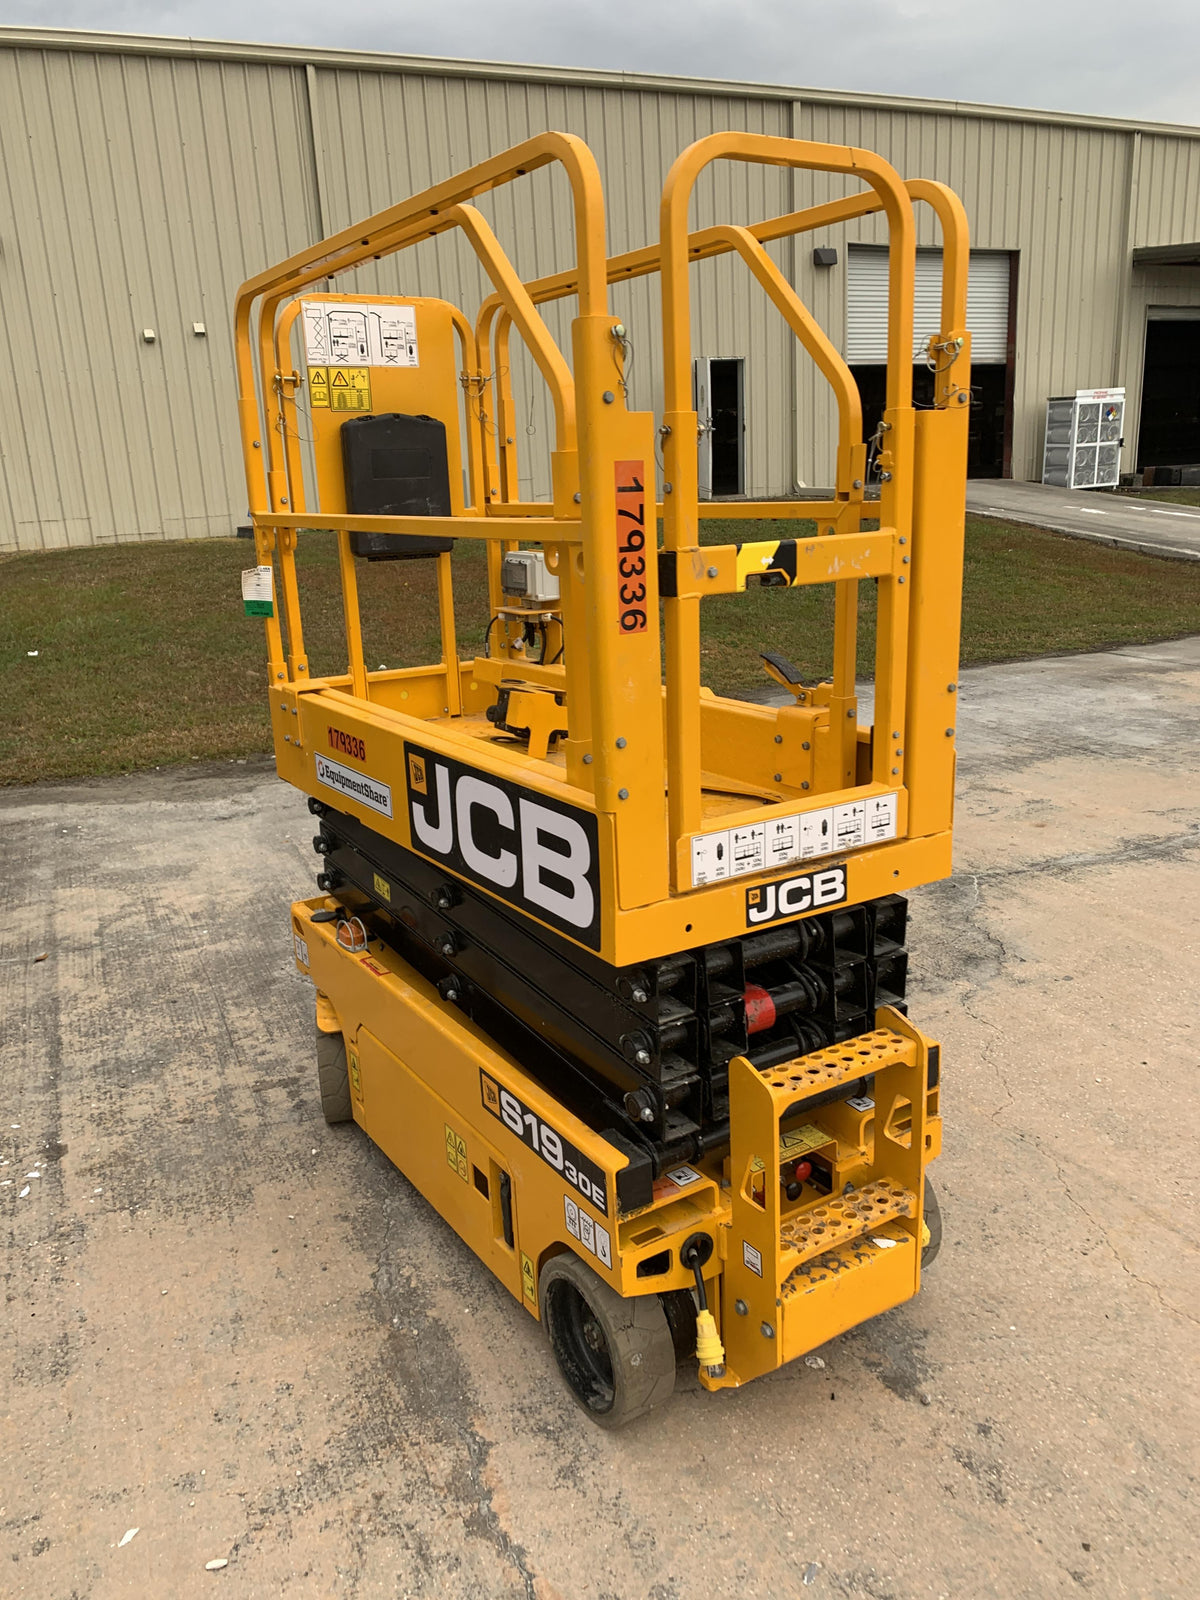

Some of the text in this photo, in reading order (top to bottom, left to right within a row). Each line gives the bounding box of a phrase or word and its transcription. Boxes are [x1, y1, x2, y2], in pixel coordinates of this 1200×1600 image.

[617, 476, 647, 631] 179336
[328, 727, 366, 760] 179336
[325, 764, 388, 807] EquipmentShare
[412, 763, 594, 928] JCB
[749, 869, 845, 922] JCB
